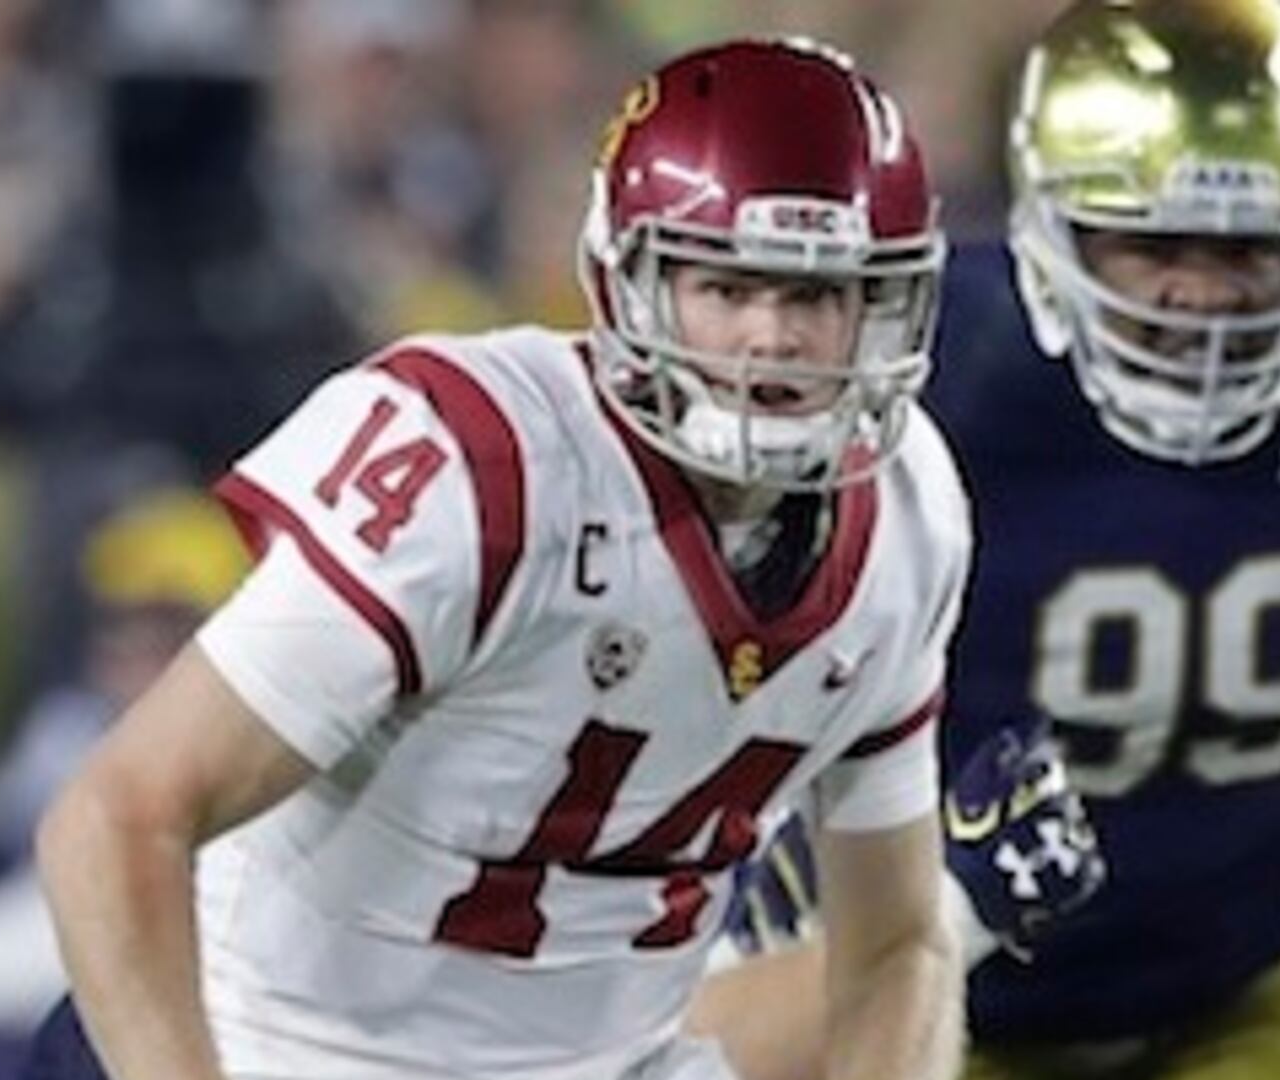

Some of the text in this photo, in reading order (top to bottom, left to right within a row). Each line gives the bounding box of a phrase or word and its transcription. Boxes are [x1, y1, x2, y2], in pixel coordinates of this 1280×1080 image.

[770, 205, 838, 235] USC
[312, 396, 452, 557] 14
[576, 522, 609, 597] C
[429, 718, 811, 960] 14
